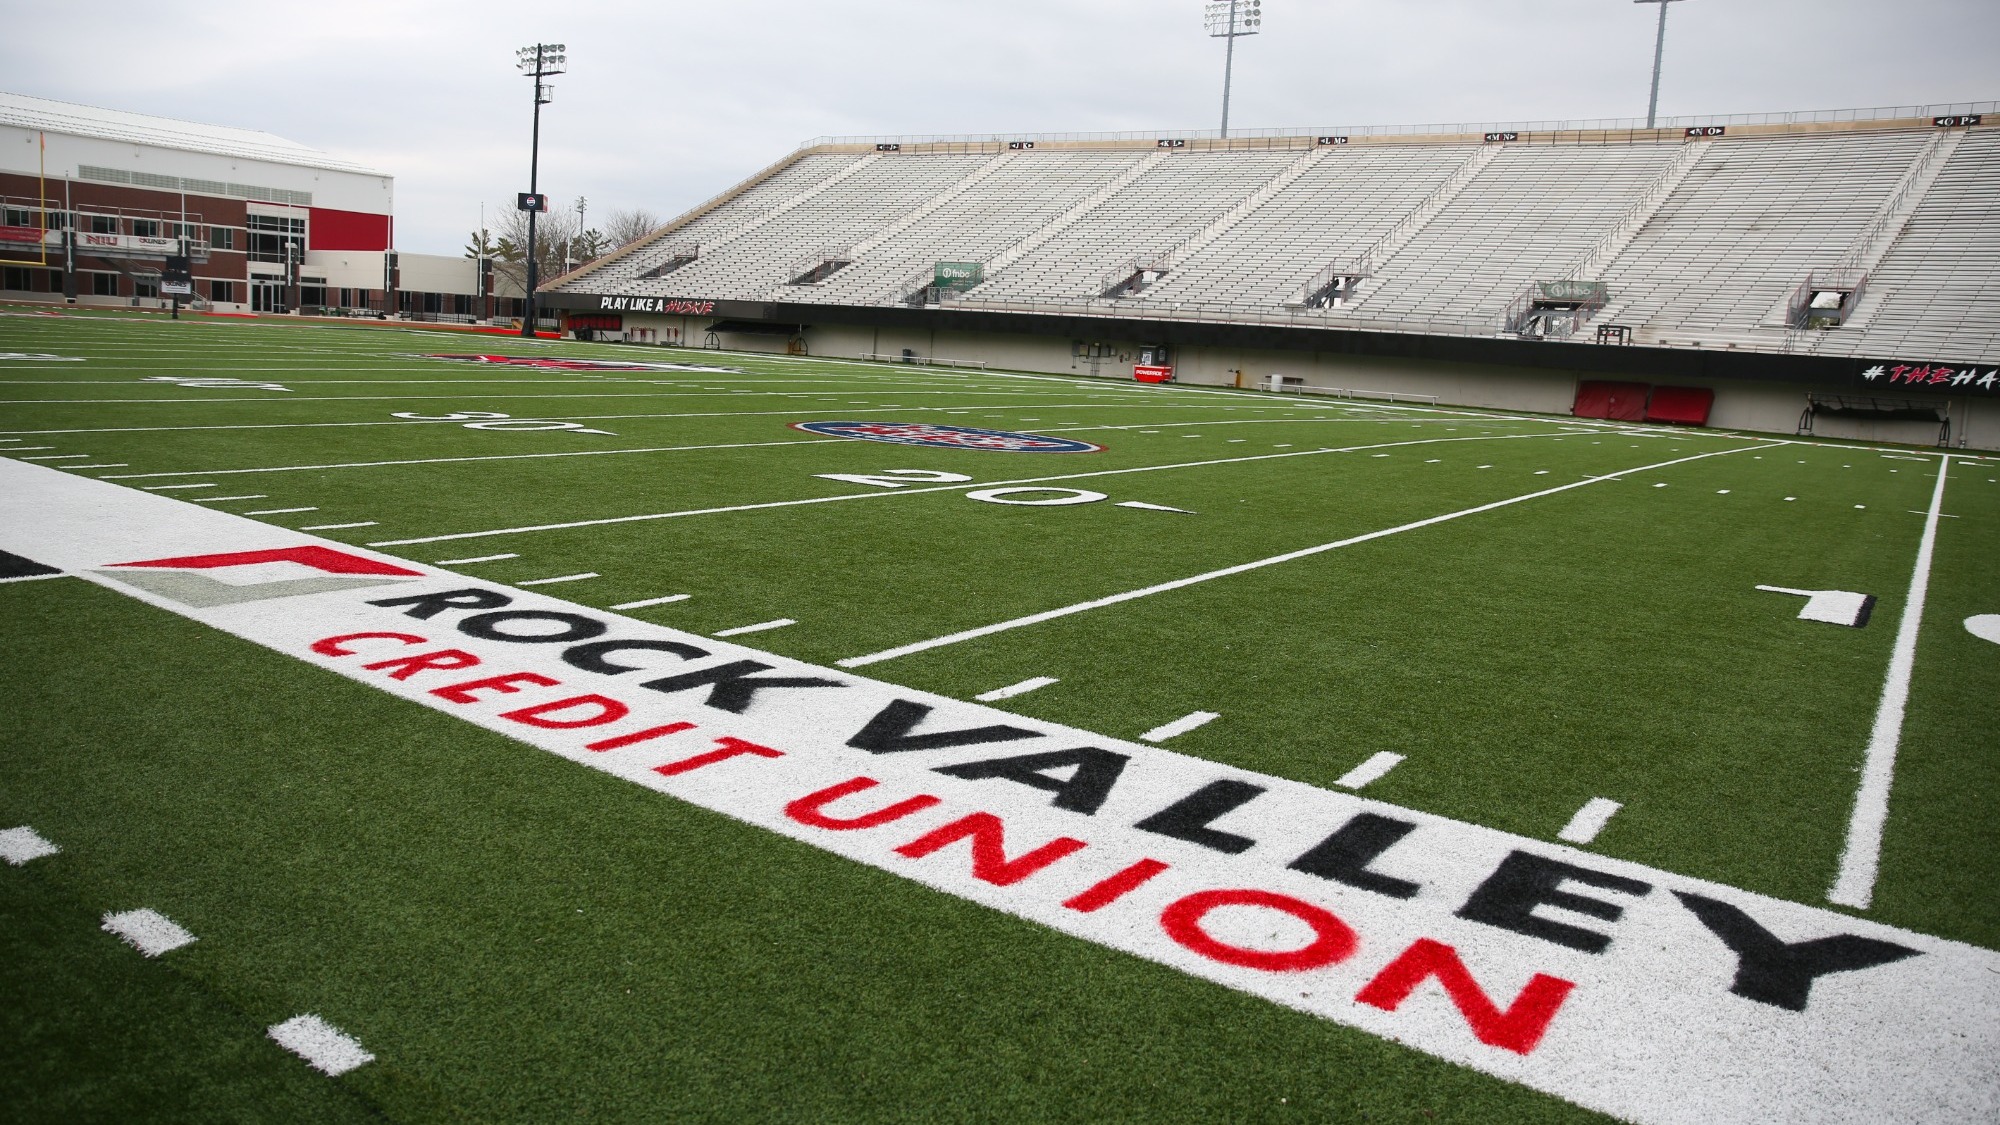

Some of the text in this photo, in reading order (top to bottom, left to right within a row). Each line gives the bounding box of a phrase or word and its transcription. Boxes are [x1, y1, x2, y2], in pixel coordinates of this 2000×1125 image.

[1960, 117, 1969, 125] P
[1707, 127, 1716, 135] O
[86, 234, 118, 246] NIU
[600, 296, 716, 315] PLAY LIKE A HUSKIE
[1135, 369, 1163, 377] POWERADE
[390, 411, 585, 431] 30
[810, 468, 1109, 507] 20
[365, 588, 1927, 1012] ROCK VALLEY
[310, 632, 1577, 1056] CREDIT UNION
